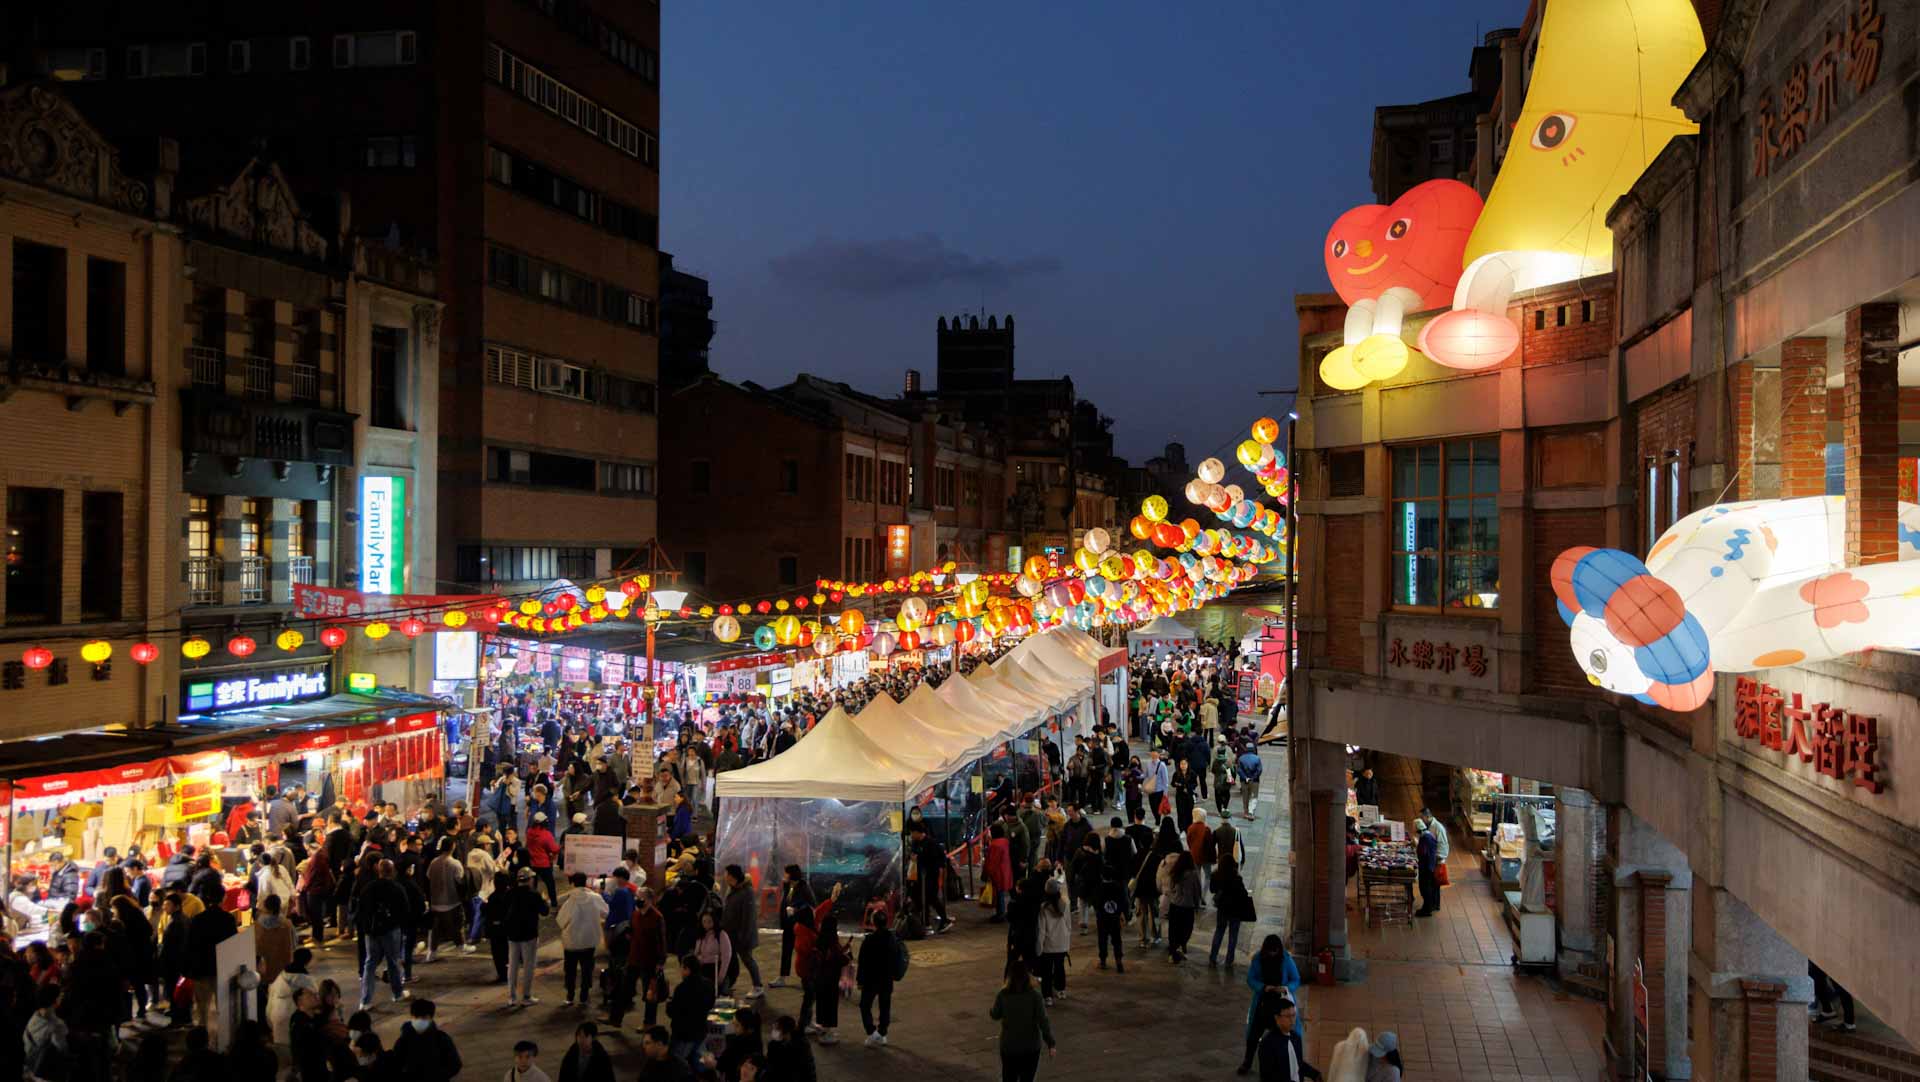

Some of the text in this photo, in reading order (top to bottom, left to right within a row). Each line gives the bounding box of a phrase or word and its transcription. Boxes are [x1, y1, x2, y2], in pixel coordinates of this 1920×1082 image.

[1753, 0, 1885, 177] 永樂市場
[367, 489, 386, 595] FamilyMar
[216, 672, 326, 705] 全家 FamilyMart
[1389, 637, 1489, 678] 永樂市場
